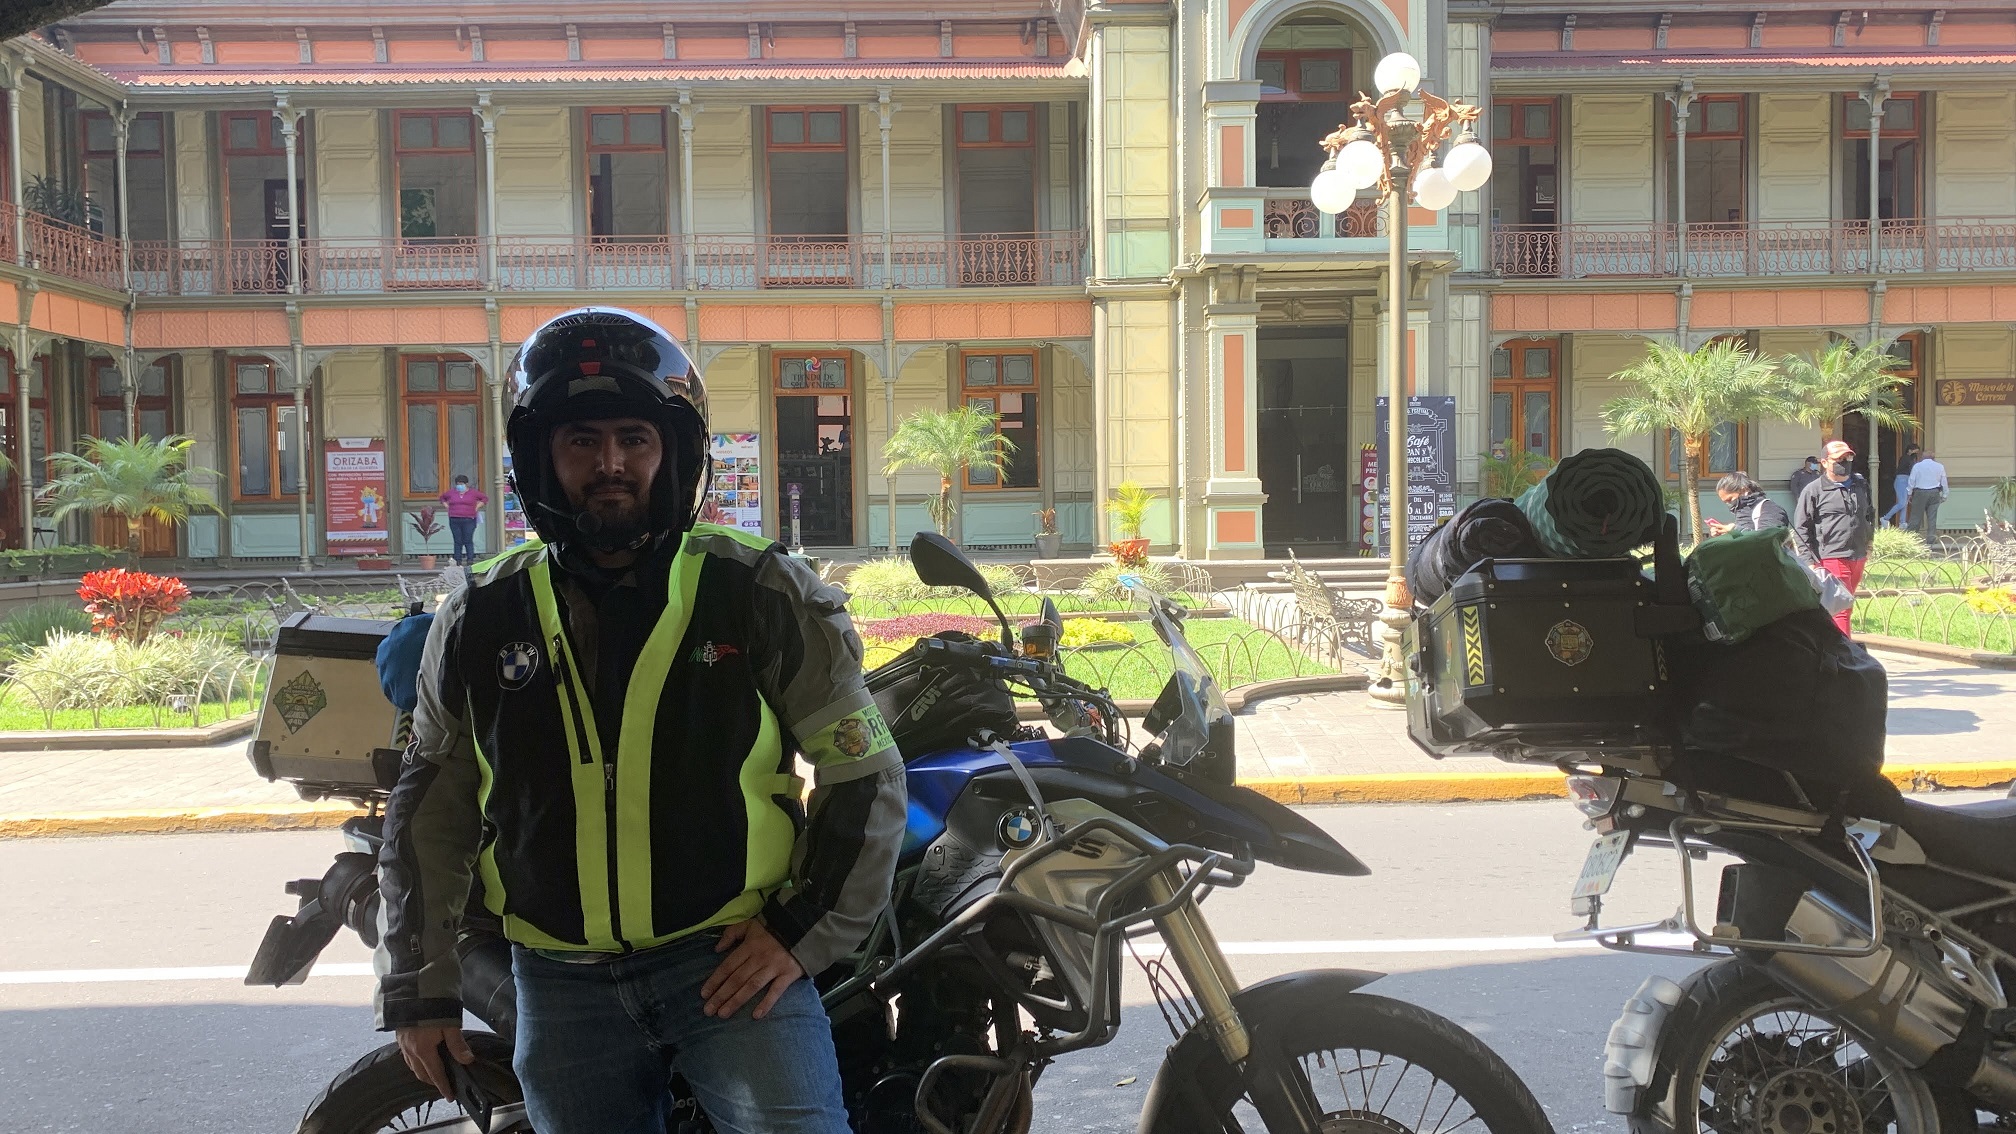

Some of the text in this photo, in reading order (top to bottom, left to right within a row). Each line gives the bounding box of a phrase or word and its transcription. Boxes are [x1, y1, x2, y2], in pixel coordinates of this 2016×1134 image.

[333, 457, 378, 466] ORIZABA
[1424, 502, 1434, 514] 19
[500, 643, 536, 658] BMW
[910, 685, 942, 722] GIVI
[1006, 810, 1038, 826] BMW
